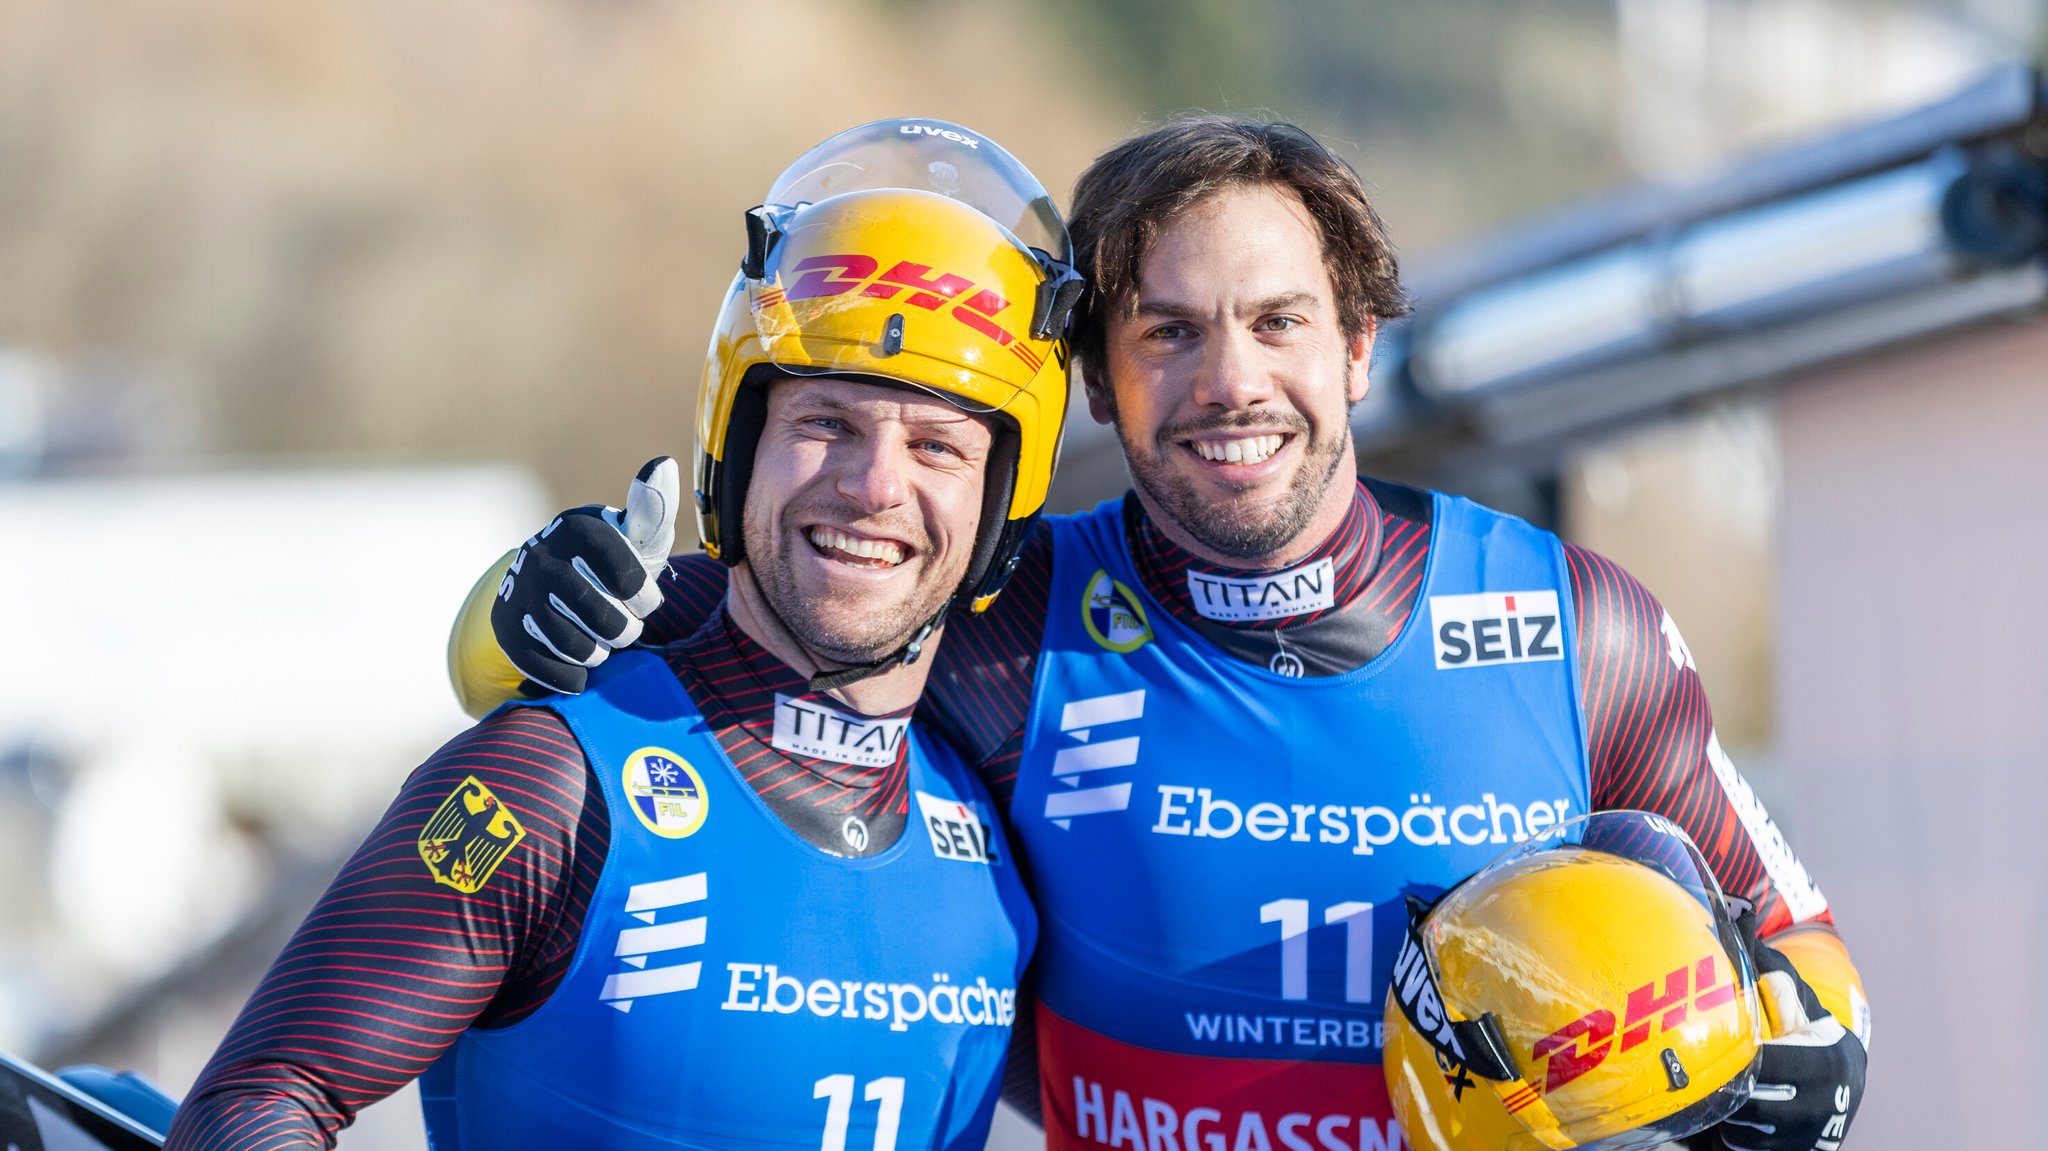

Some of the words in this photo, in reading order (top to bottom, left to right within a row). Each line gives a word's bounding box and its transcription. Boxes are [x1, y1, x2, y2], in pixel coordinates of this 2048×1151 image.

[900, 124, 979, 149] uvex
[783, 254, 1016, 347] DHL
[1267, 602, 1322, 616] GERMANY
[1439, 596, 1559, 664] SEIZ
[792, 743, 827, 756] MADE
[658, 801, 687, 818] FIL
[930, 805, 998, 861] SEIZ
[1152, 784, 1570, 855] Eberspächer
[1260, 898, 1373, 1004] 11
[720, 962, 1017, 1032] Eberspäche
[1532, 955, 1736, 1095] DHL
[813, 1073, 906, 1151] 11
[1810, 1084, 1850, 1151] SEI
